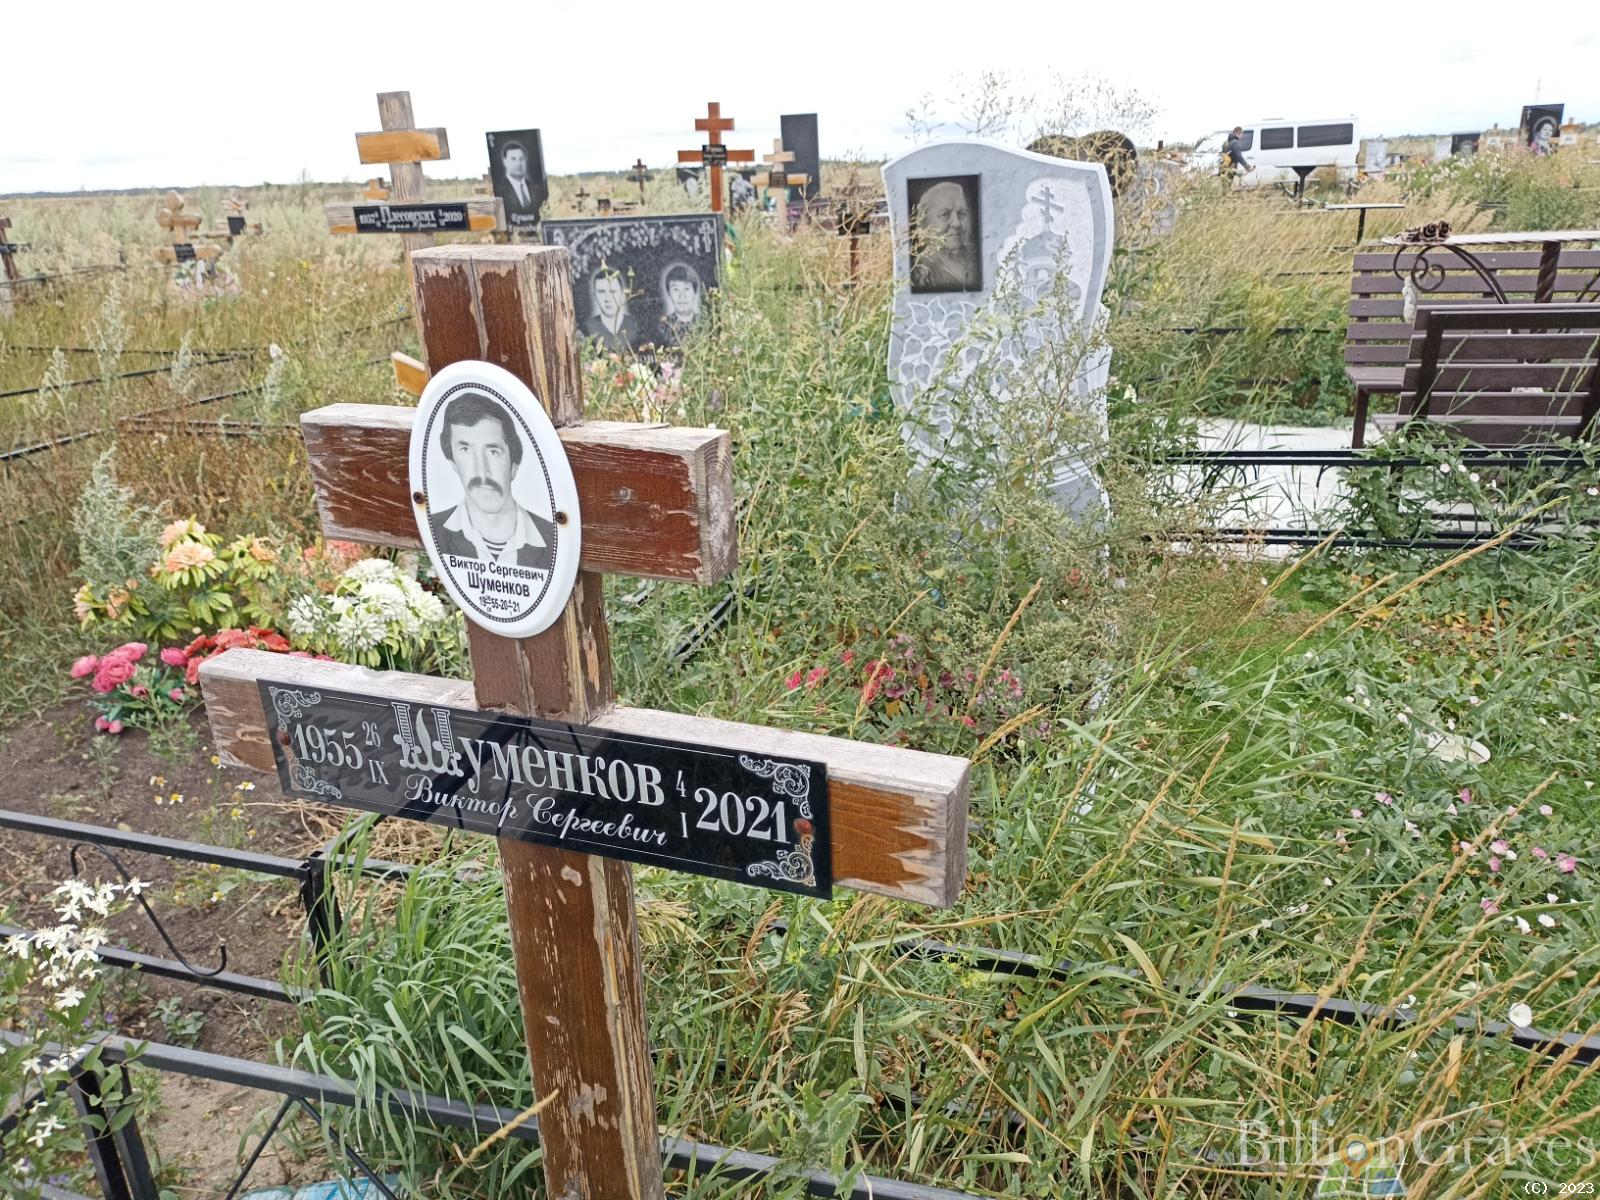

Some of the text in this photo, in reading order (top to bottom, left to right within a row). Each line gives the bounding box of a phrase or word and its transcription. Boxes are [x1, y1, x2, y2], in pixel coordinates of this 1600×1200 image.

[449, 555, 544, 582] Виктор Сергеевич
[467, 571, 531, 597] Шуменков
[361, 720, 381, 748] 26
[294, 701, 666, 807] 1955 Шуменков
[368, 759, 390, 785] IX
[676, 769, 687, 798] 4
[404, 773, 668, 846] Виктор Сергеевич
[694, 787, 791, 844] 2021
